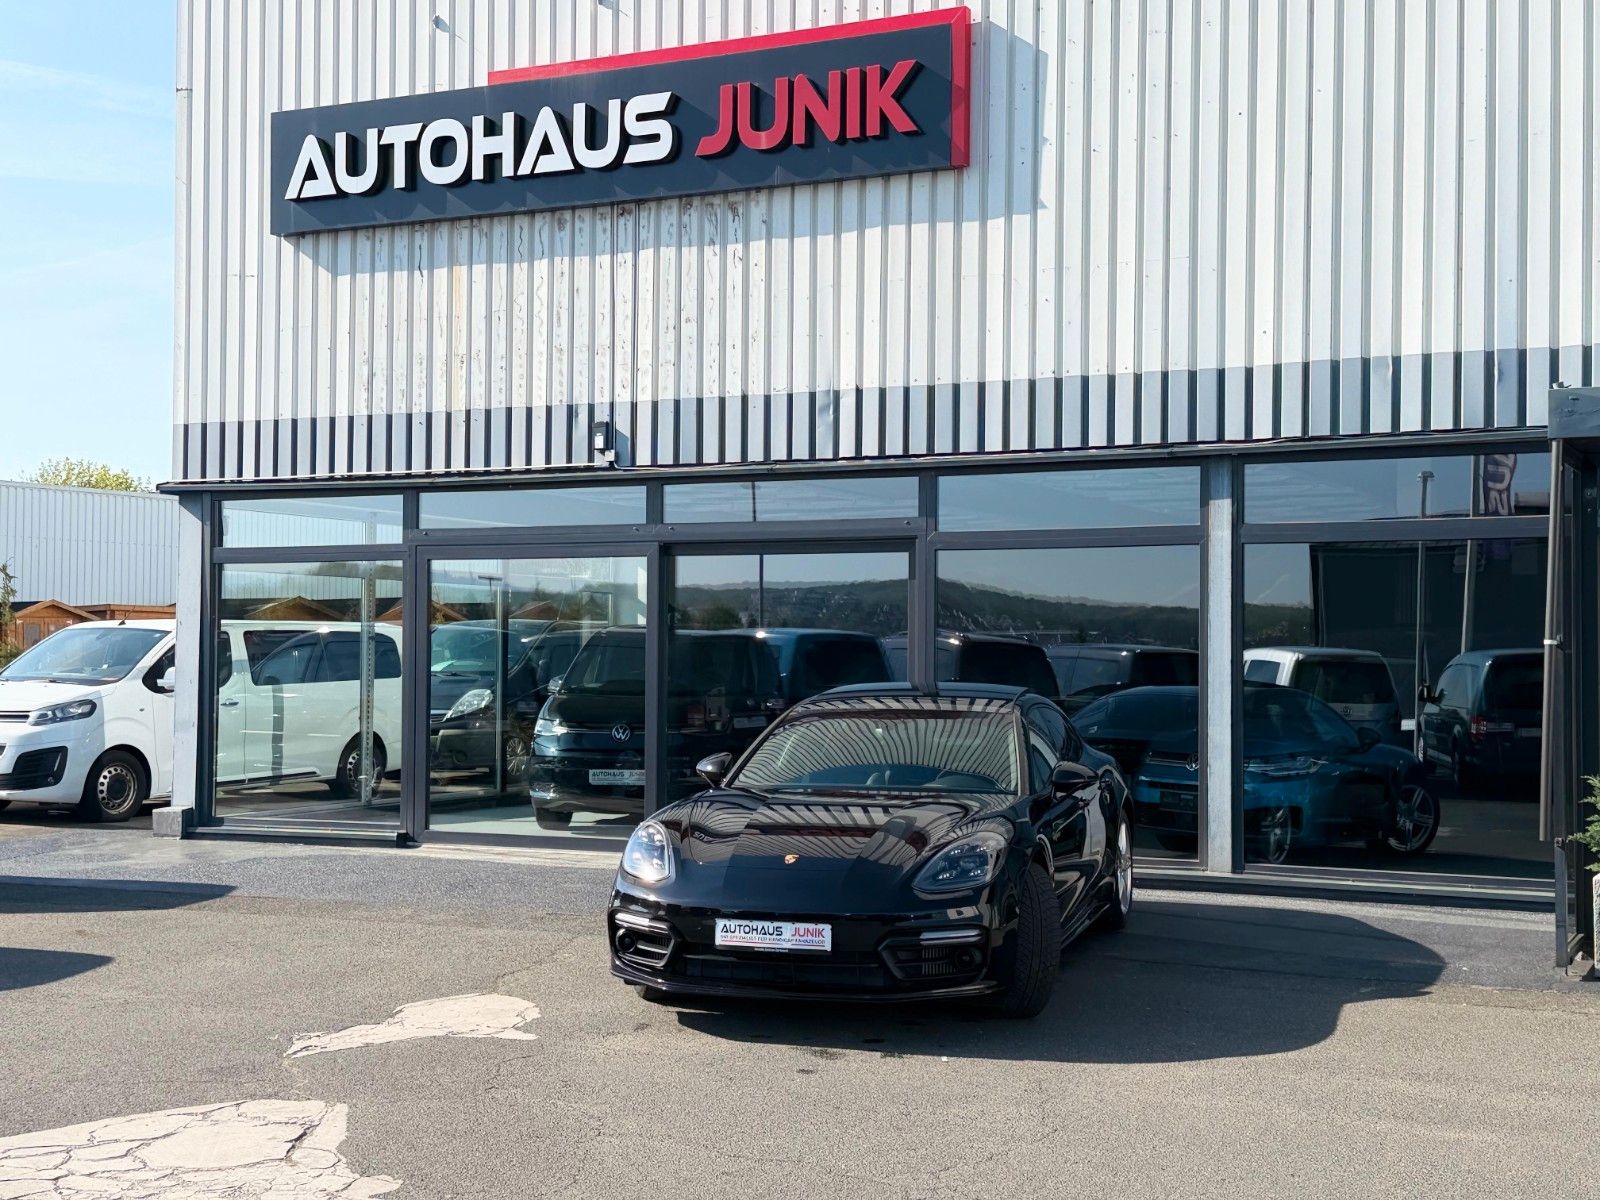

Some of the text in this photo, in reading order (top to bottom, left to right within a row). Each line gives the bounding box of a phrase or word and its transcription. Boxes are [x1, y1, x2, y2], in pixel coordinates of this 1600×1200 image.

[285, 59, 919, 200] AUTOHAUS JUNIK
[720, 923, 826, 939] AUTOHAUS JUNIK
